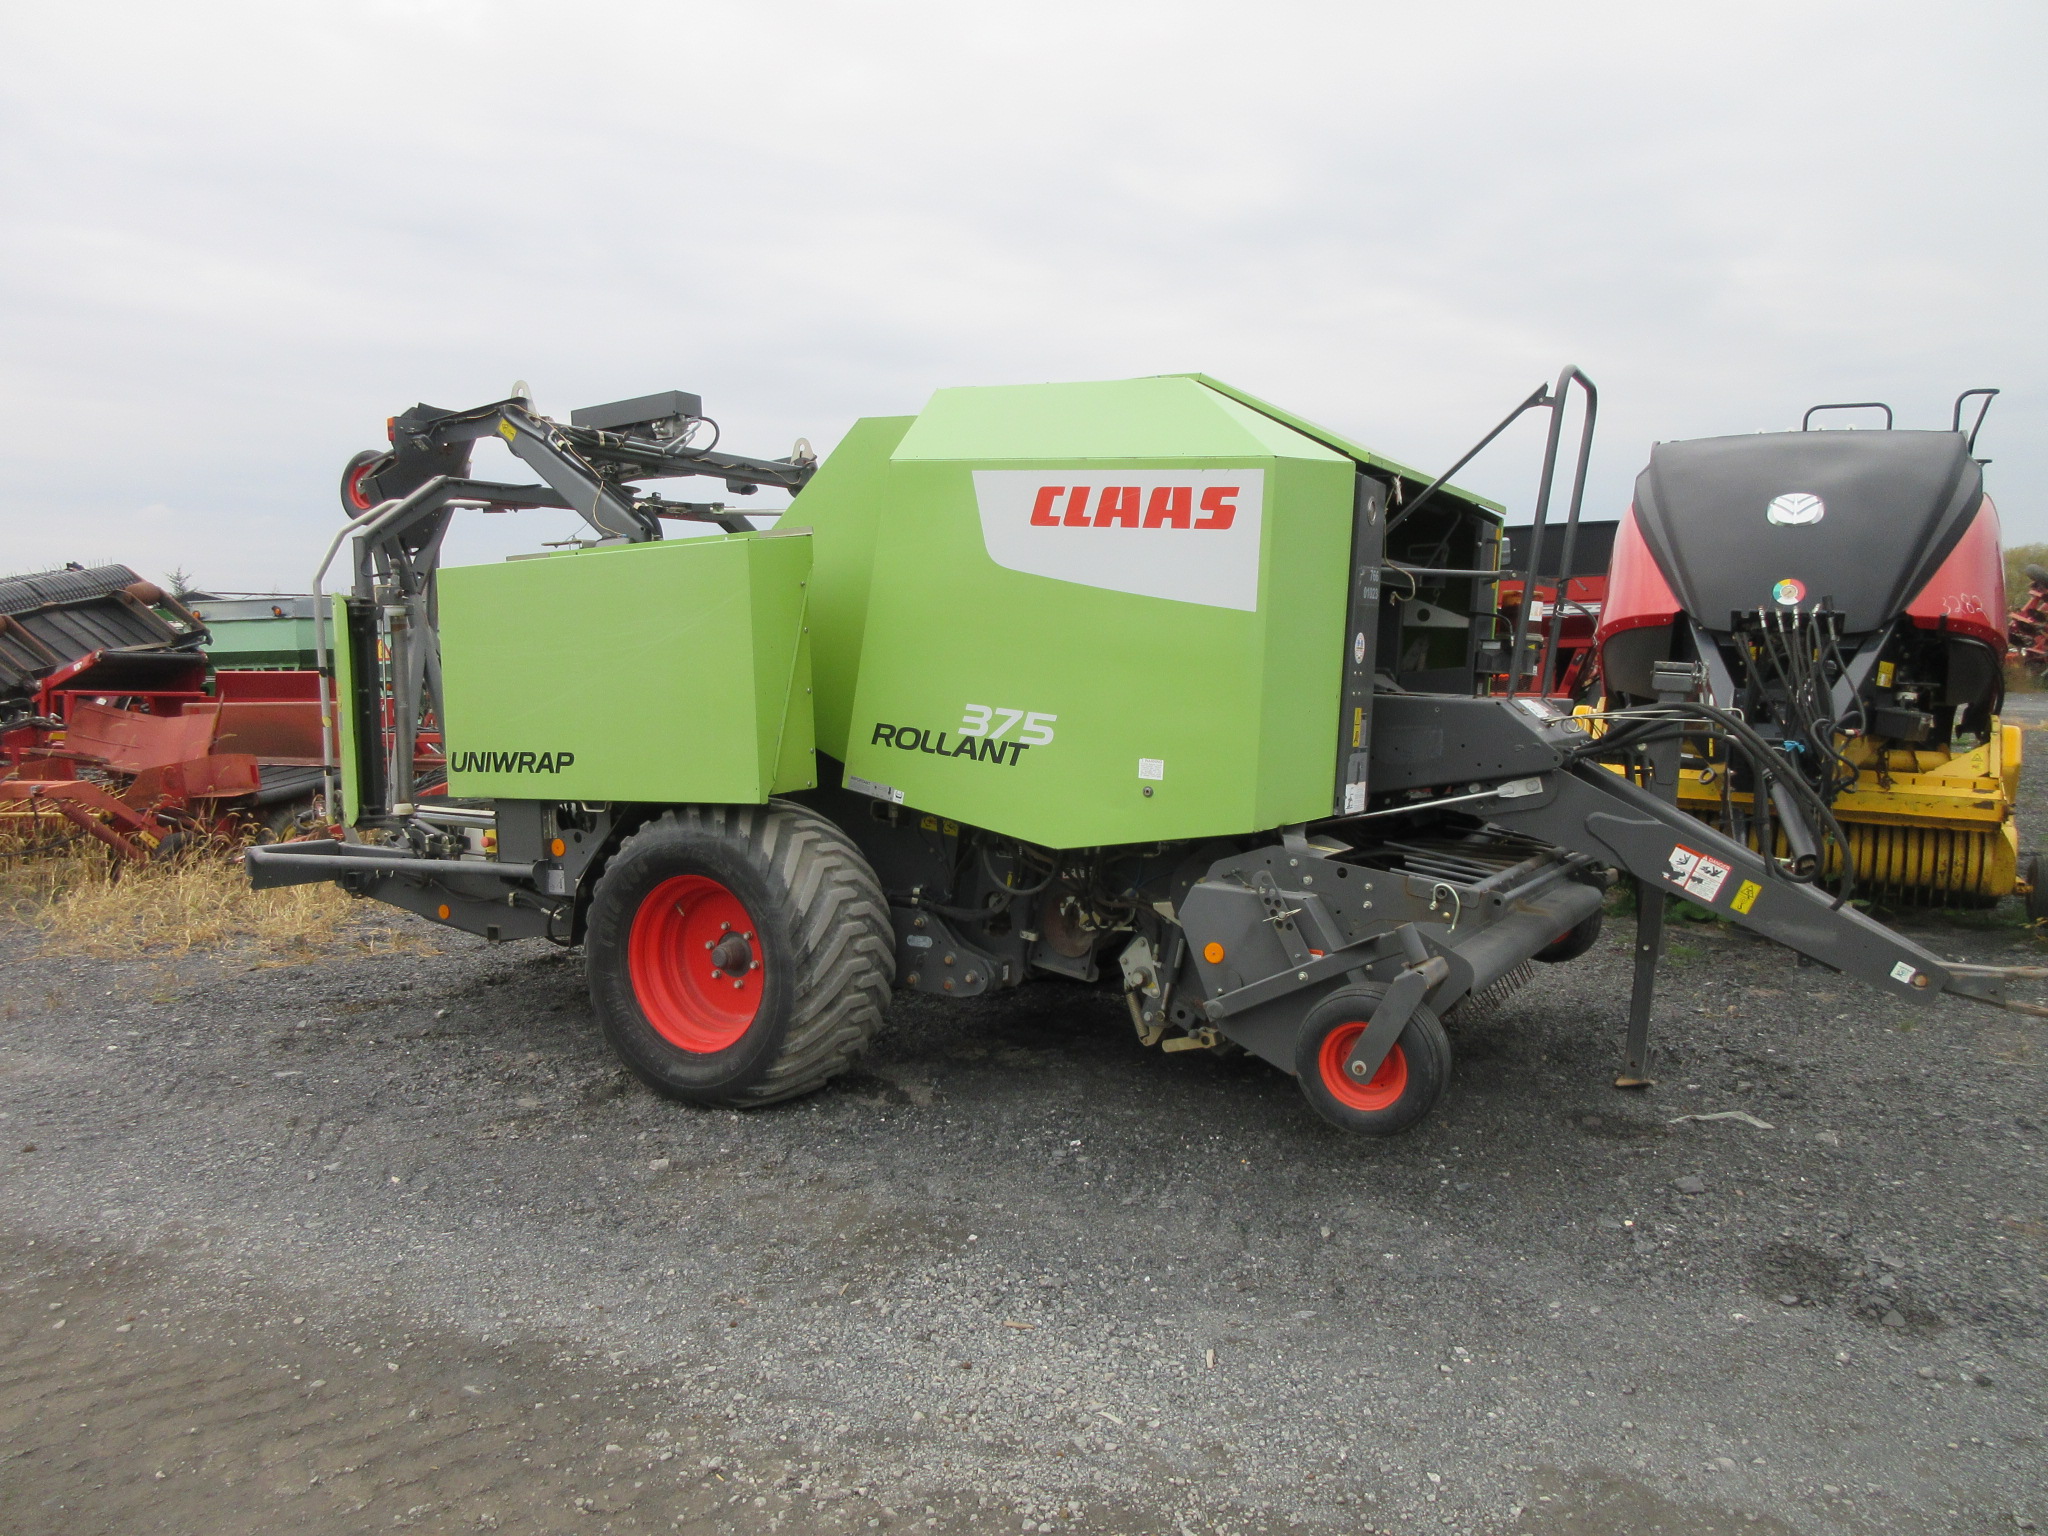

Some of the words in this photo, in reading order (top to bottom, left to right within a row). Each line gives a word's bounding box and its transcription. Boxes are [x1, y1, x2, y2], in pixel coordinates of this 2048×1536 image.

[1030, 486, 1240, 529] CLAAS
[871, 722, 1030, 767] ROLLANT
[958, 703, 1057, 746] 375
[451, 751, 575, 774] UNIWRAP
[1708, 857, 1731, 871] DANGER
